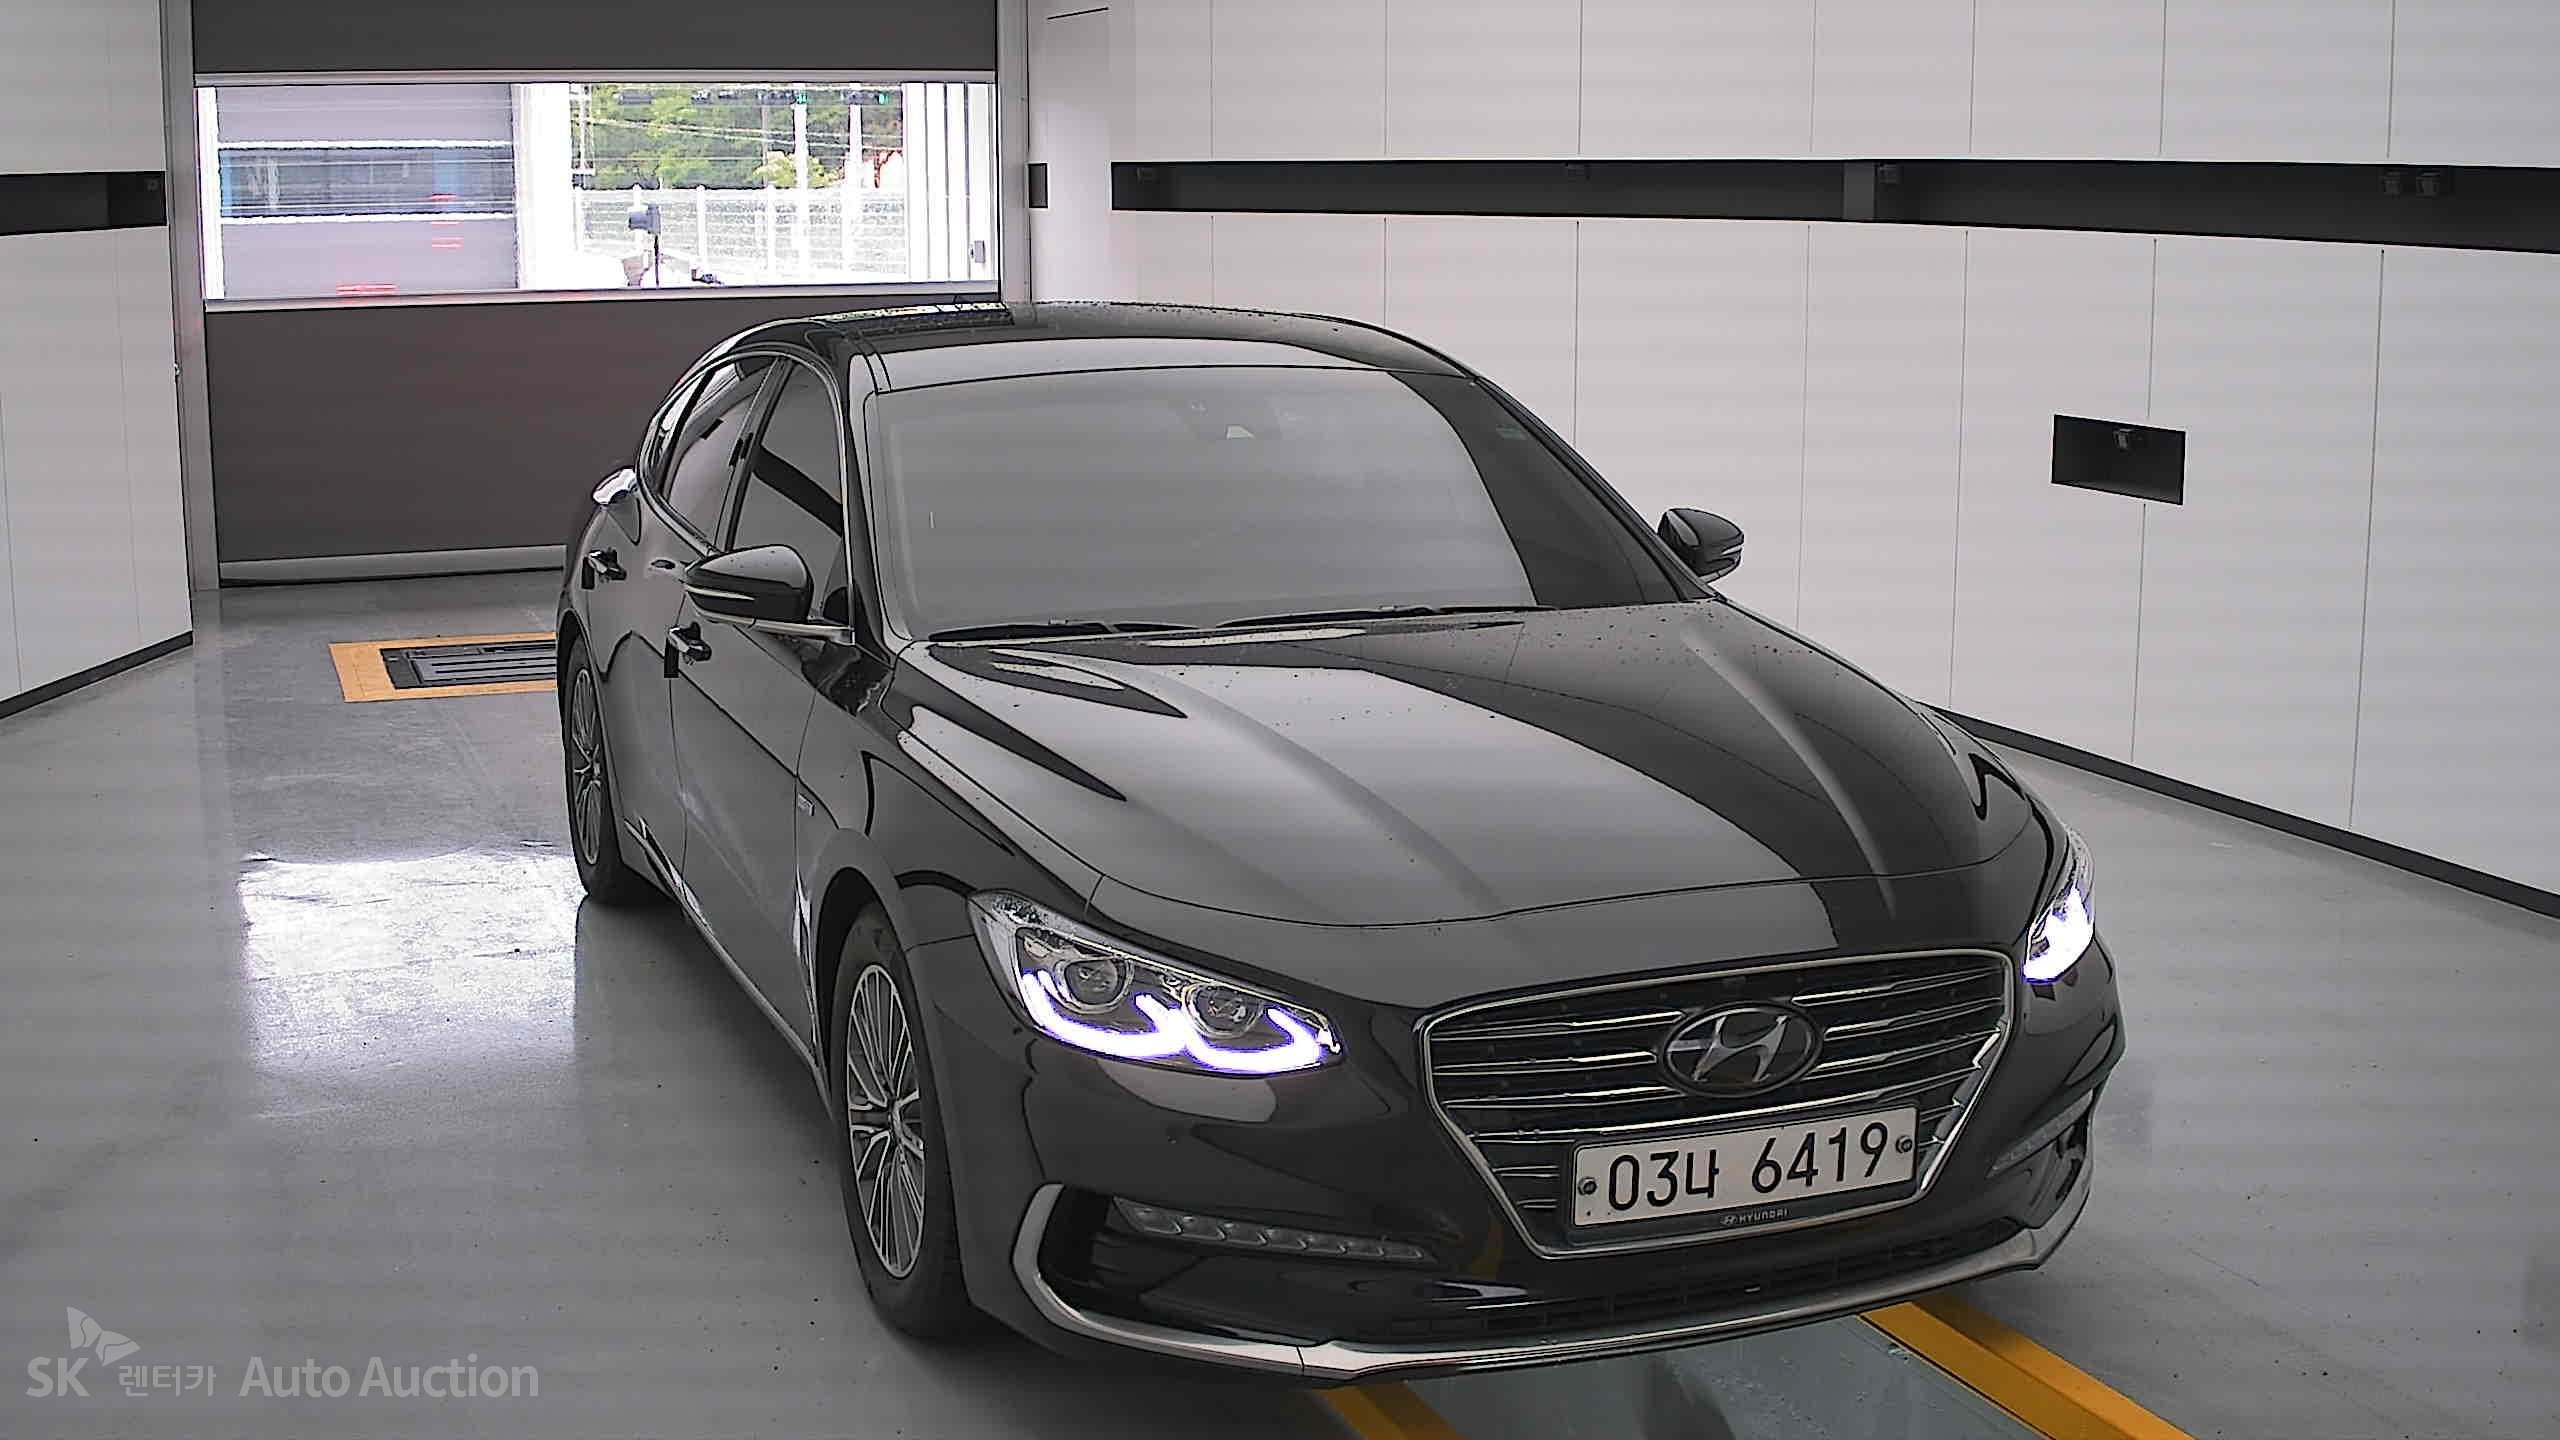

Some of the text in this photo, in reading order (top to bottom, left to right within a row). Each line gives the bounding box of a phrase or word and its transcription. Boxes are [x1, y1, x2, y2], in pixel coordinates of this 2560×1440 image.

[1608, 1122, 1888, 1210] 03나 6419
[1739, 1207, 1788, 1223] HYUNDAI
